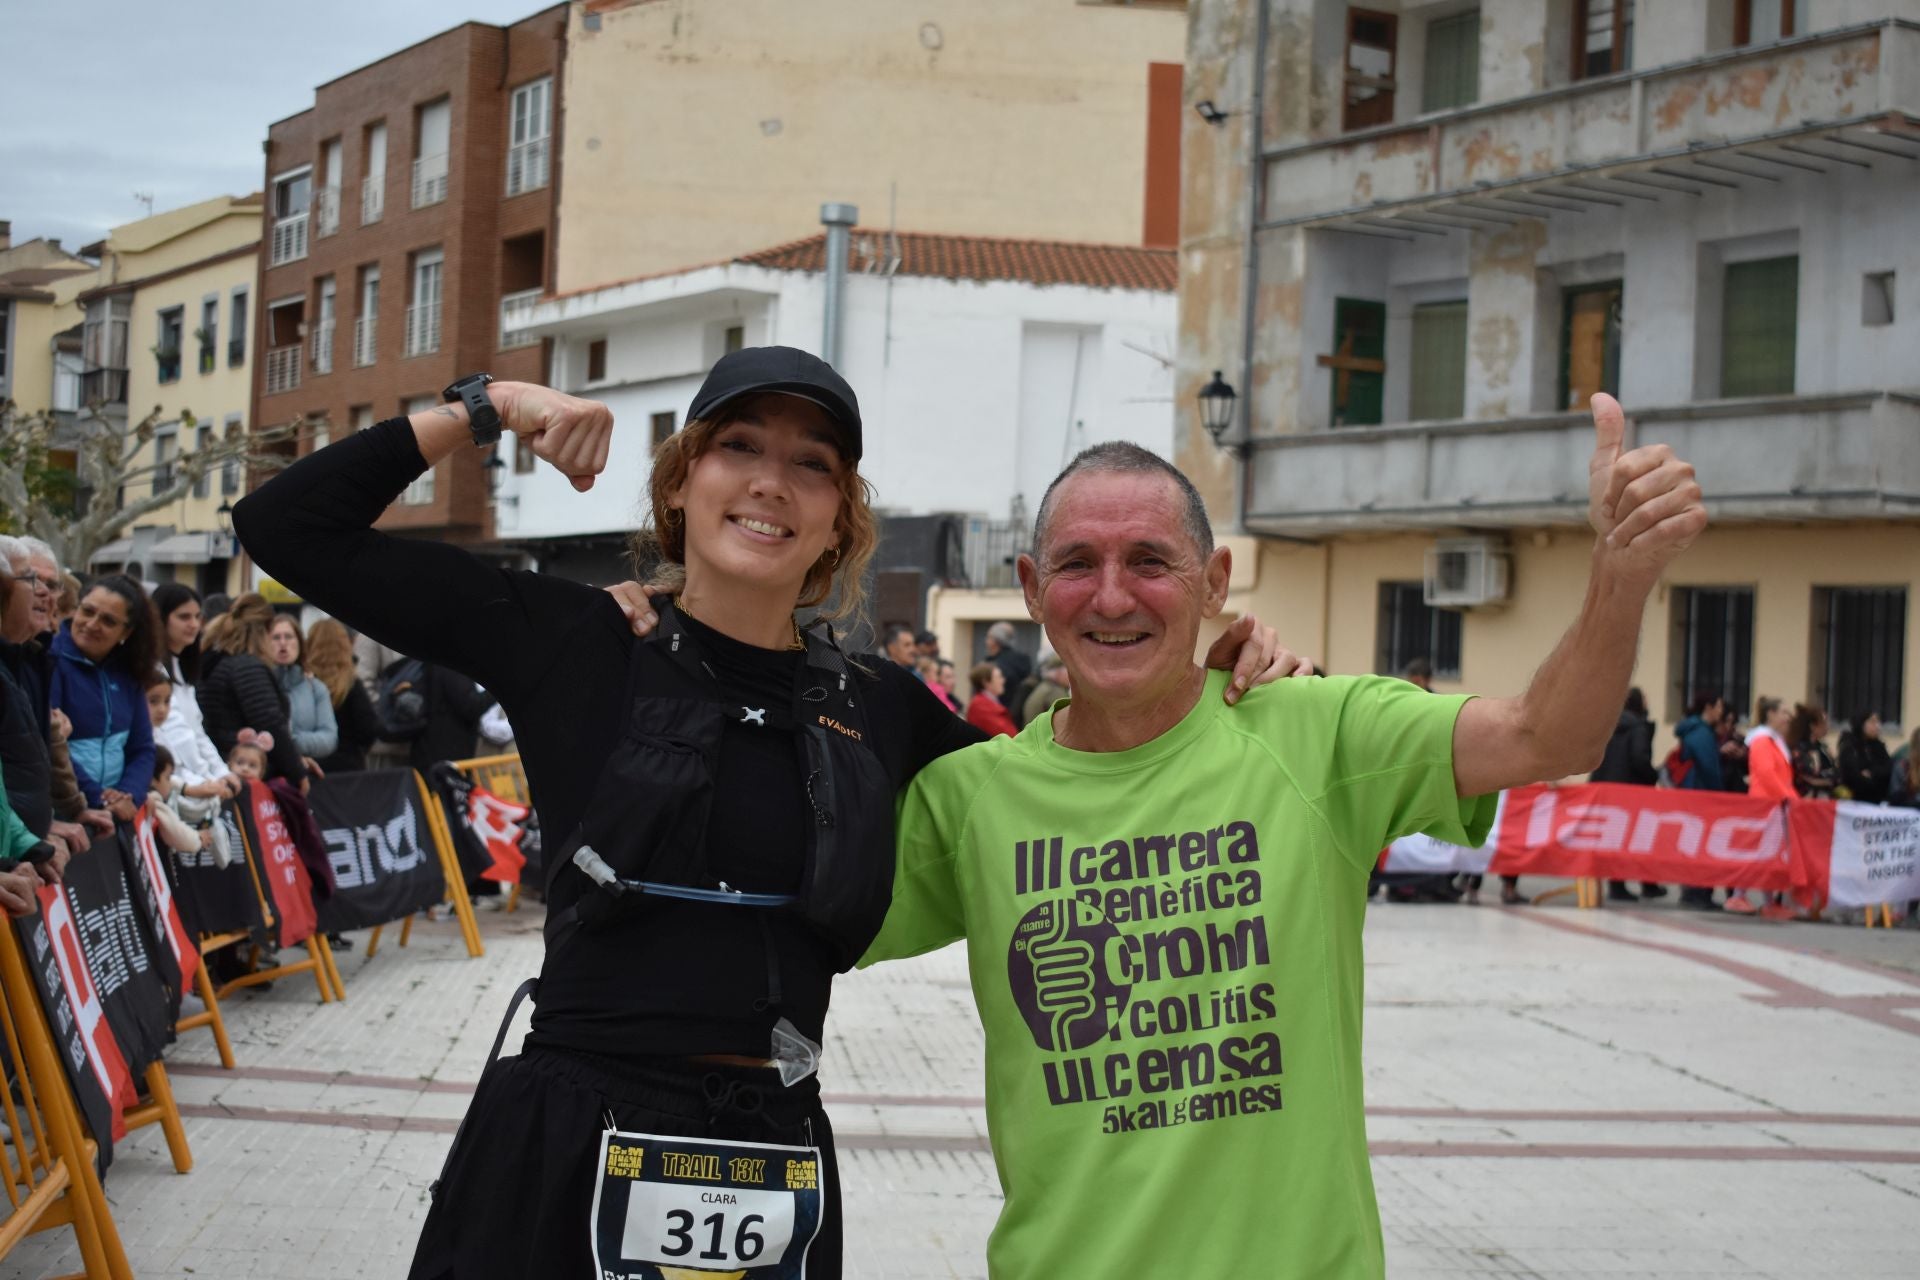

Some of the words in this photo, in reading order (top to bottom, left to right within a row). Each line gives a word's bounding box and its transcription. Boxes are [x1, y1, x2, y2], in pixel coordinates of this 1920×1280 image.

[818, 715, 862, 741] EVADICT
[1525, 790, 1787, 863] land
[1864, 826, 1919, 849] STARTS
[320, 797, 422, 888] and
[1863, 849, 1885, 866] ON
[1891, 843, 1917, 860] THE
[1015, 837, 1063, 895] III
[1069, 820, 1261, 885] carrera
[1867, 862, 1916, 881] INSIDE
[661, 1151, 722, 1181] TRAIL
[728, 1157, 766, 1183] 13K
[700, 1192, 738, 1205] CLARA
[660, 1208, 765, 1262] 316
